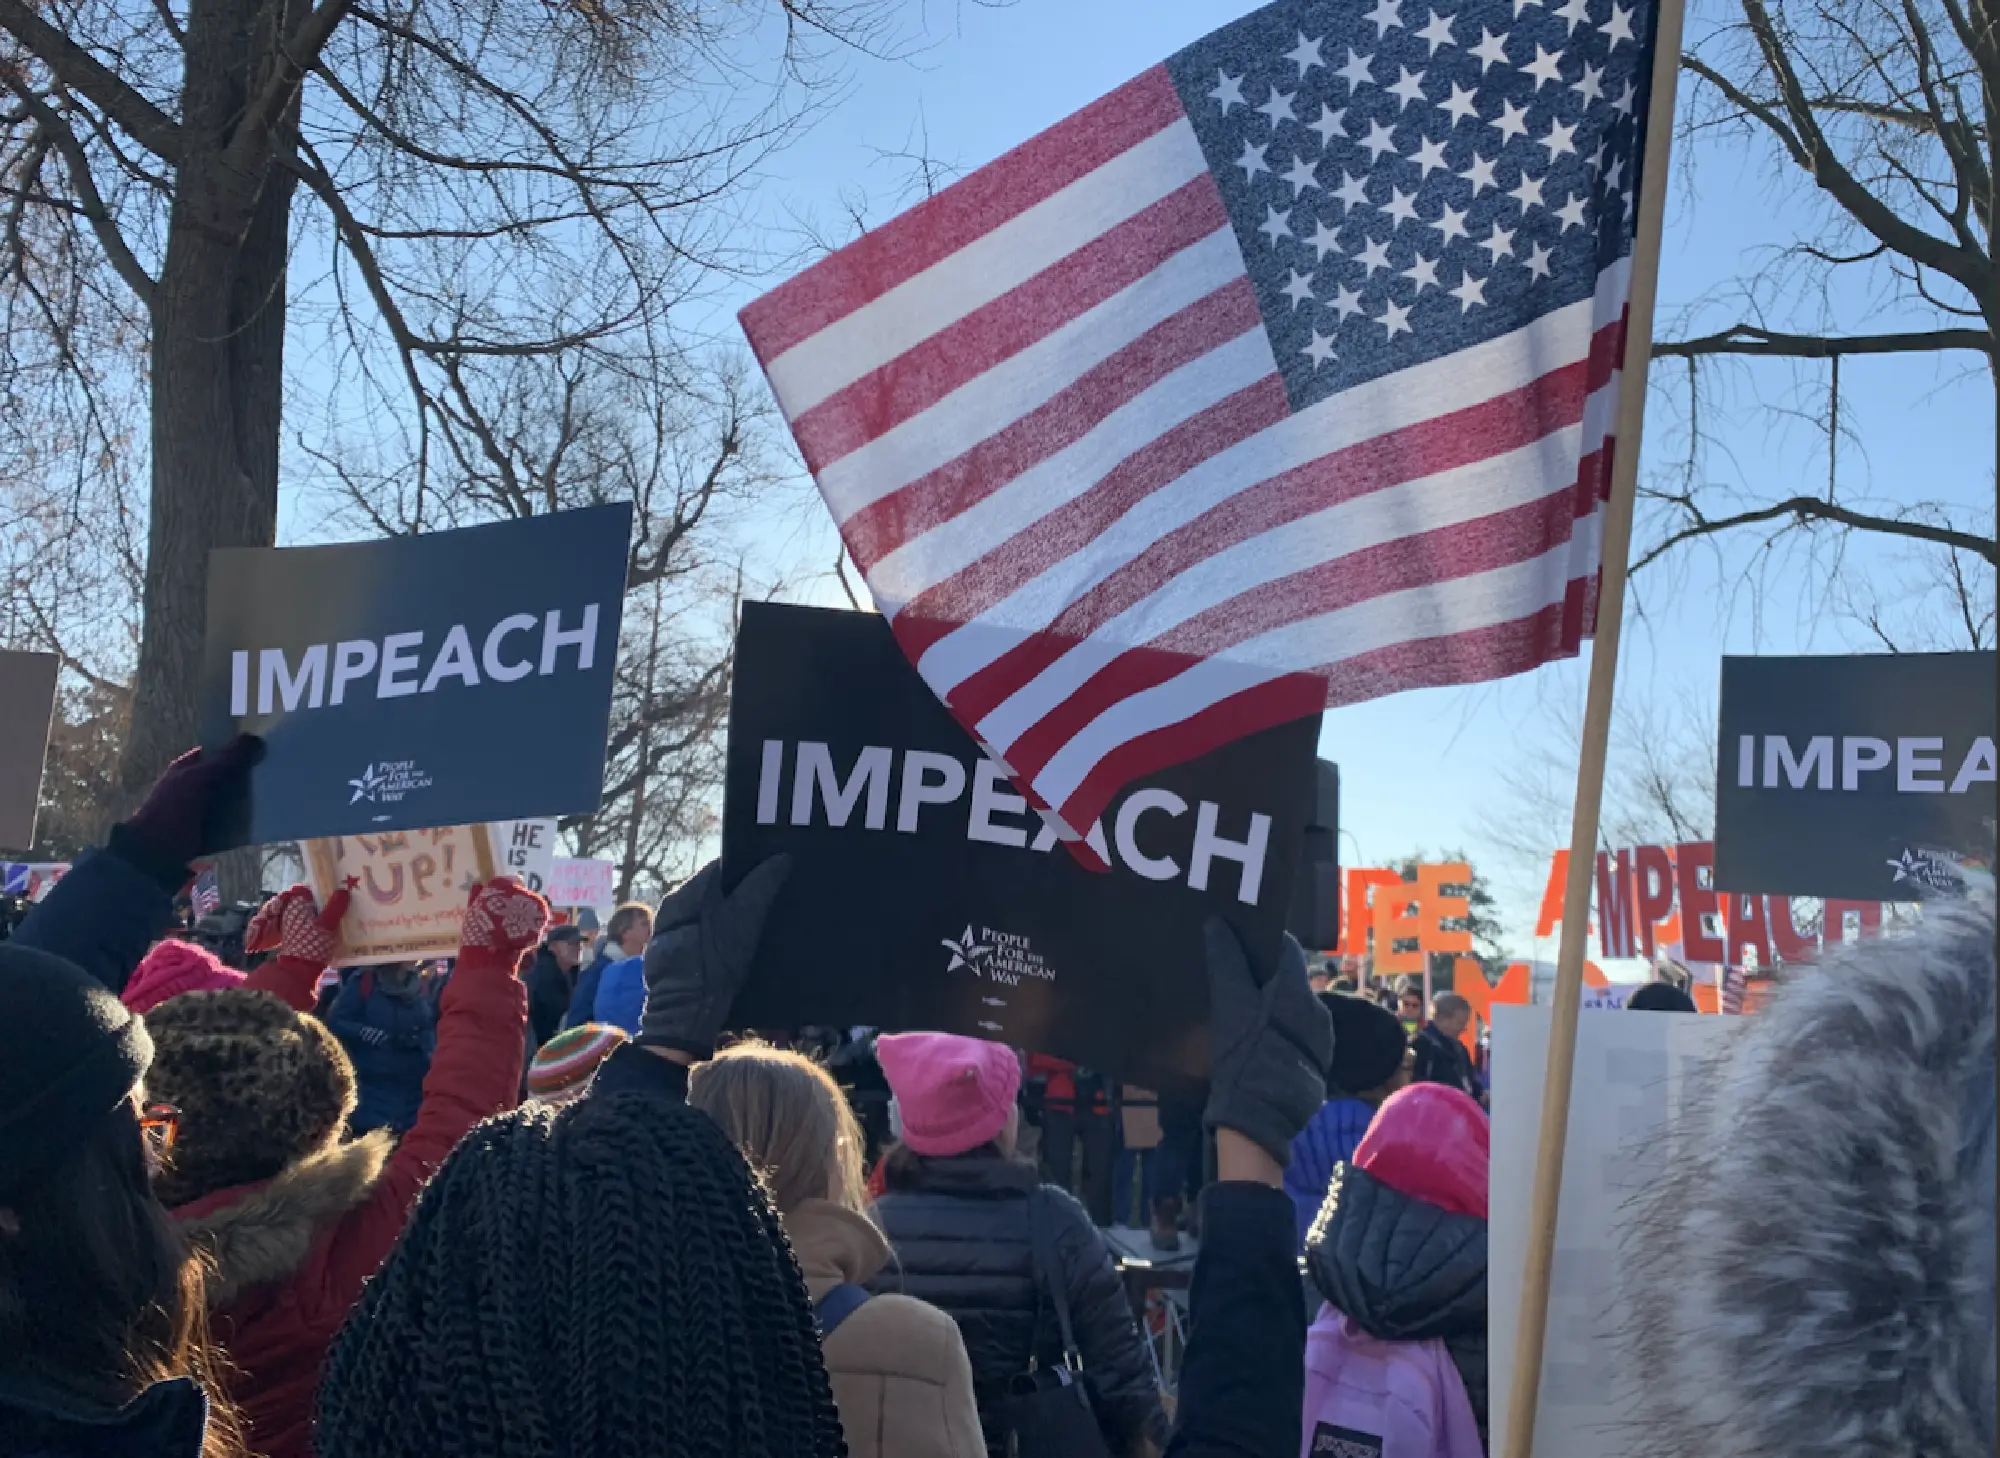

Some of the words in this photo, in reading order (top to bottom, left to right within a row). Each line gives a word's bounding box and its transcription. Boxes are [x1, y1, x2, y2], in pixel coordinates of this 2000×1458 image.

[230, 603, 600, 716] IMPEACH
[512, 822, 545, 848] HE
[507, 848, 527, 867] IS
[362, 843, 455, 906] UP!
[1597, 841, 1881, 966] MPEAC
[982, 926, 1030, 949] PEOPLE
[998, 944, 1024, 961] FOR
[984, 954, 1056, 981] AMERICAN
[990, 967, 1020, 986] WAY
